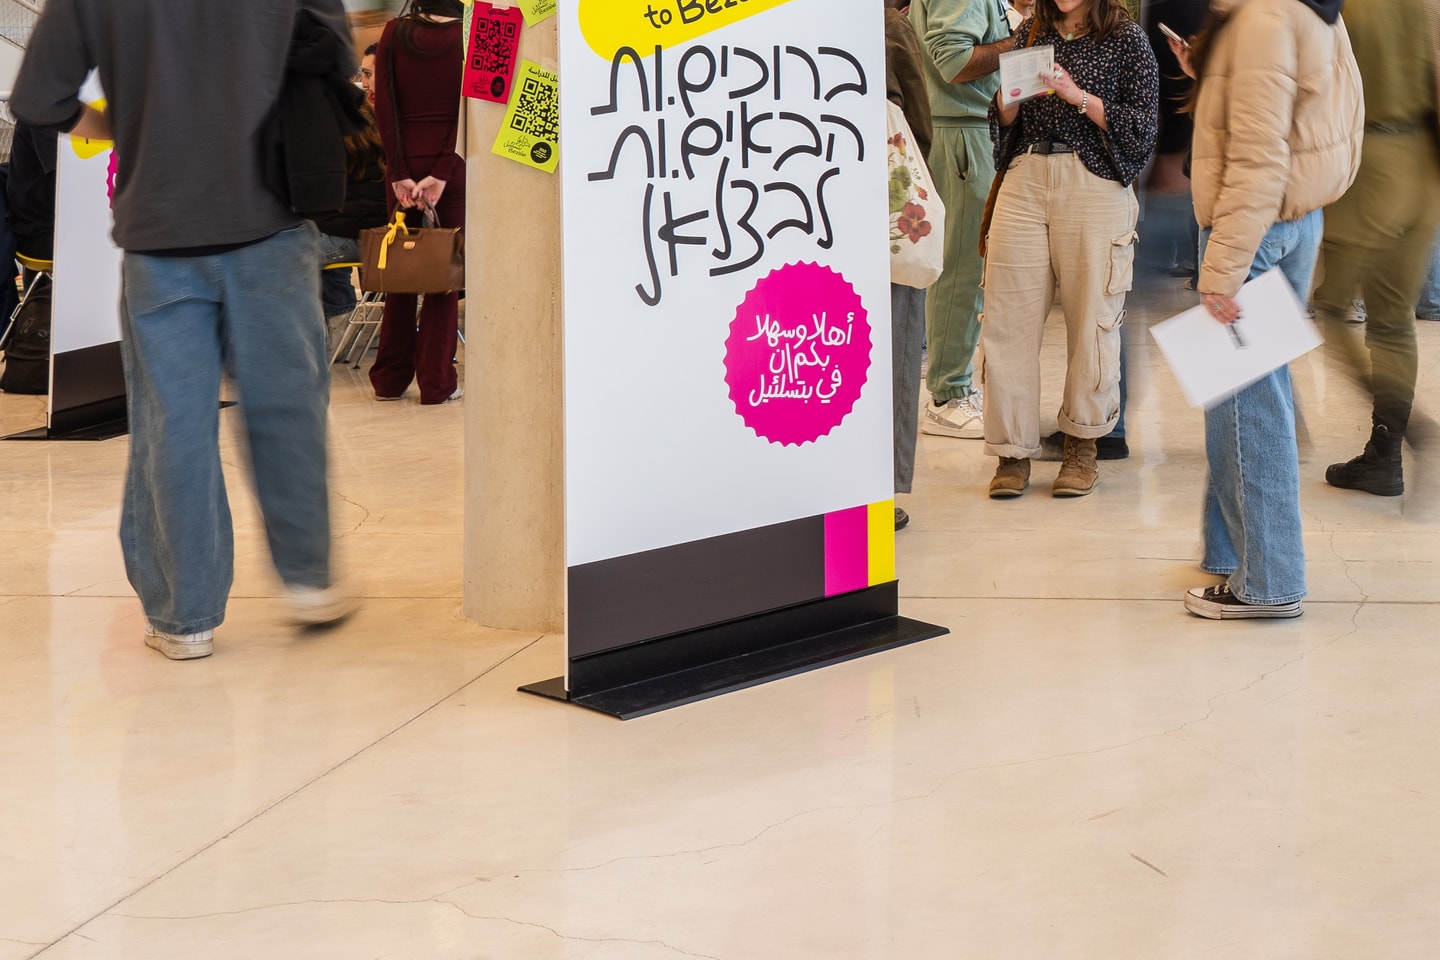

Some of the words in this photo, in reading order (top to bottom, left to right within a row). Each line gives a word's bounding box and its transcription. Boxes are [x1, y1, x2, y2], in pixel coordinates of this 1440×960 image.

[643, 4, 673, 29] to
[635, 156, 841, 307] לבצלאל
[815, 364, 842, 404] في
